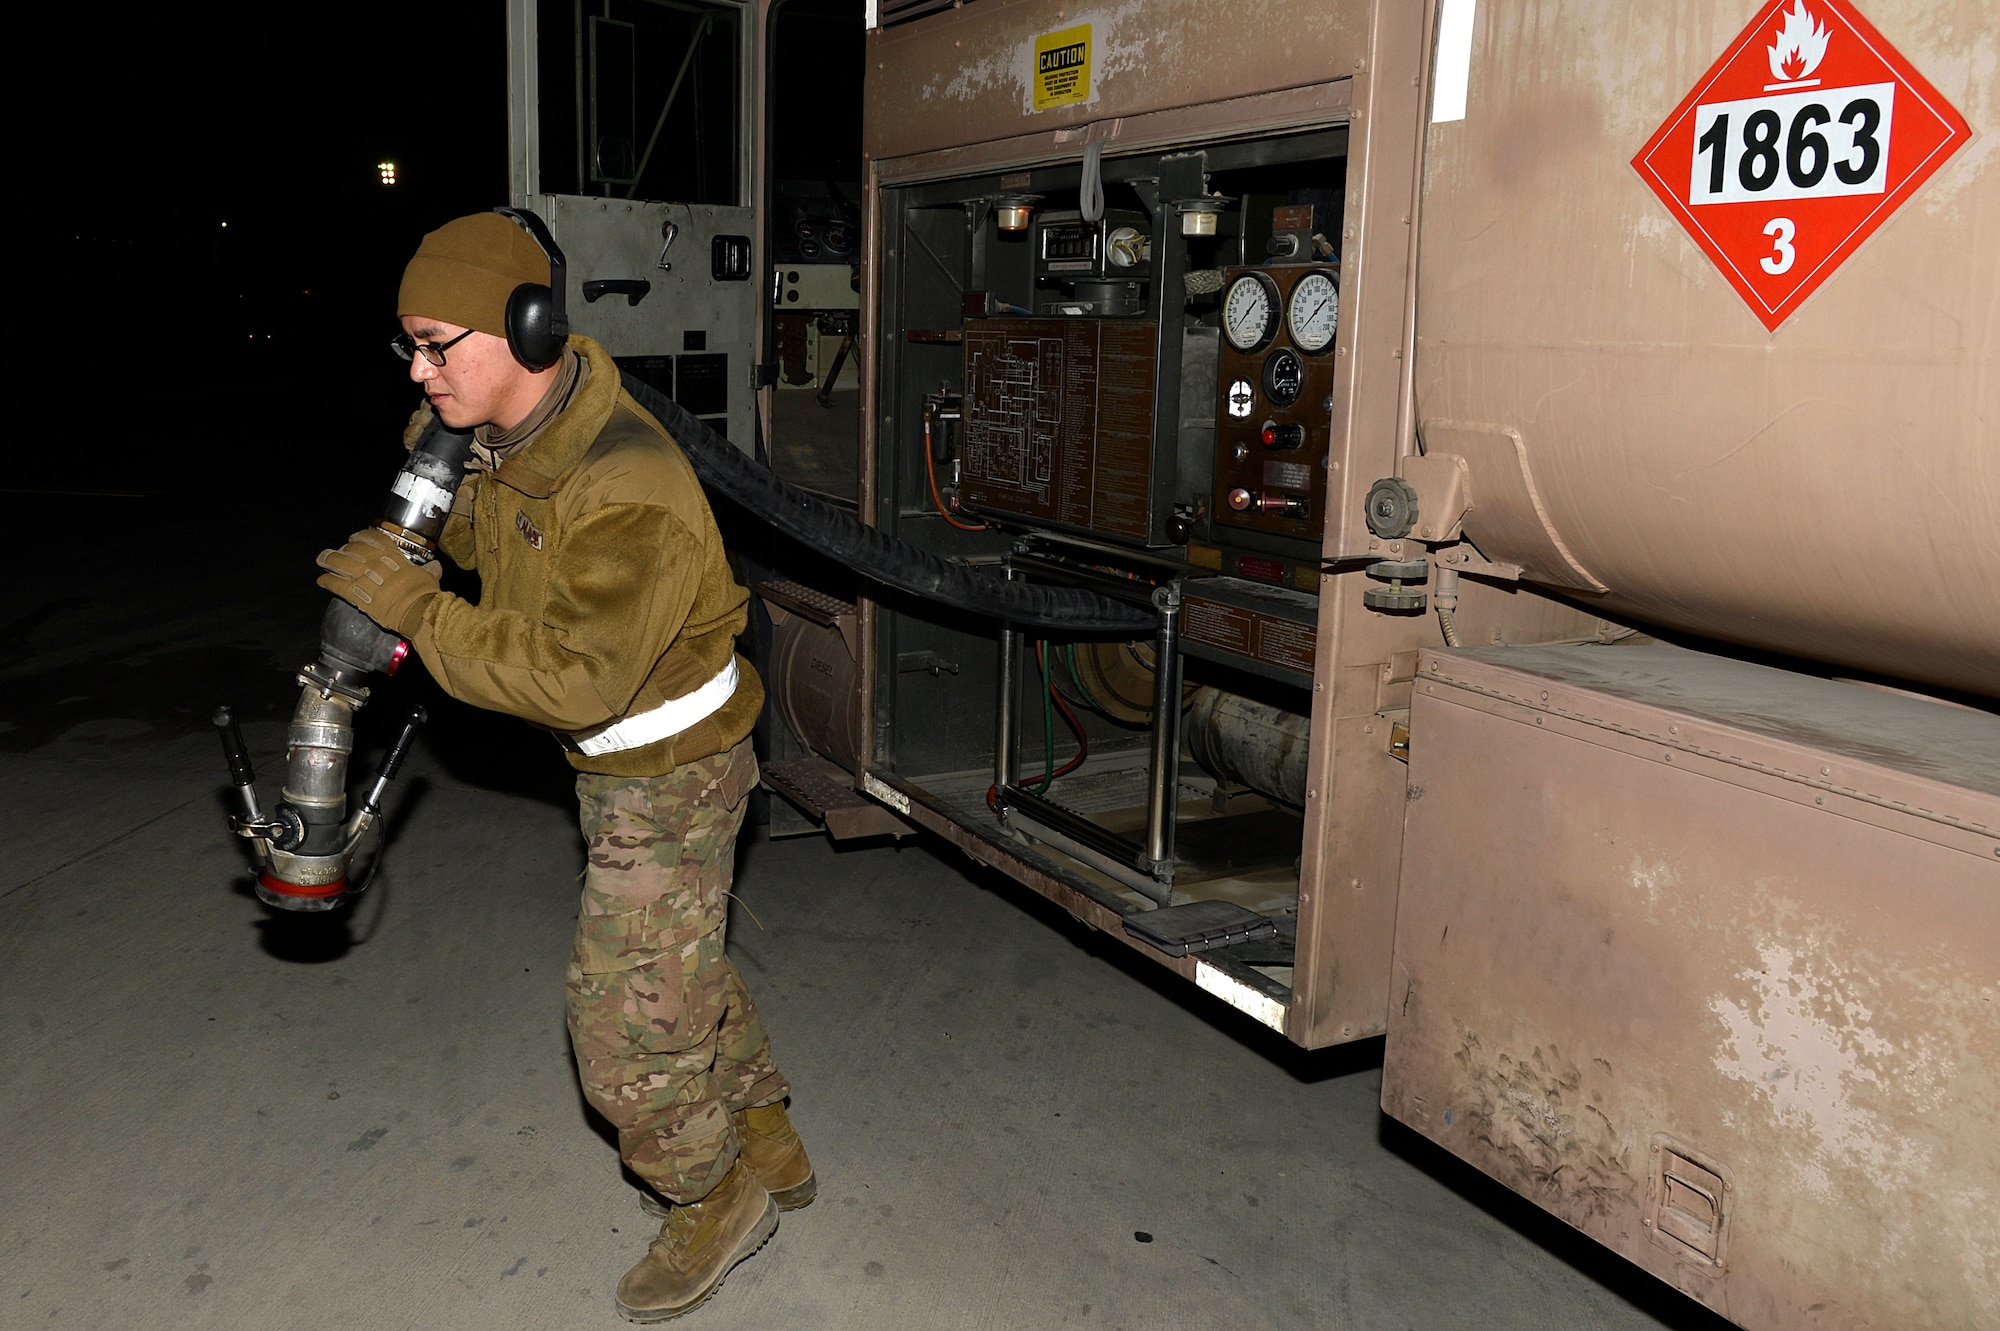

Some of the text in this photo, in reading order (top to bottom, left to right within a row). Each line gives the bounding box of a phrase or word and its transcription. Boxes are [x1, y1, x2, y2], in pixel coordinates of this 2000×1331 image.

[1040, 46, 1084, 70] CAUTION
[1698, 97, 1881, 193] 1863
[1760, 217, 1796, 275] 3
[811, 658, 833, 678] DIESEL
